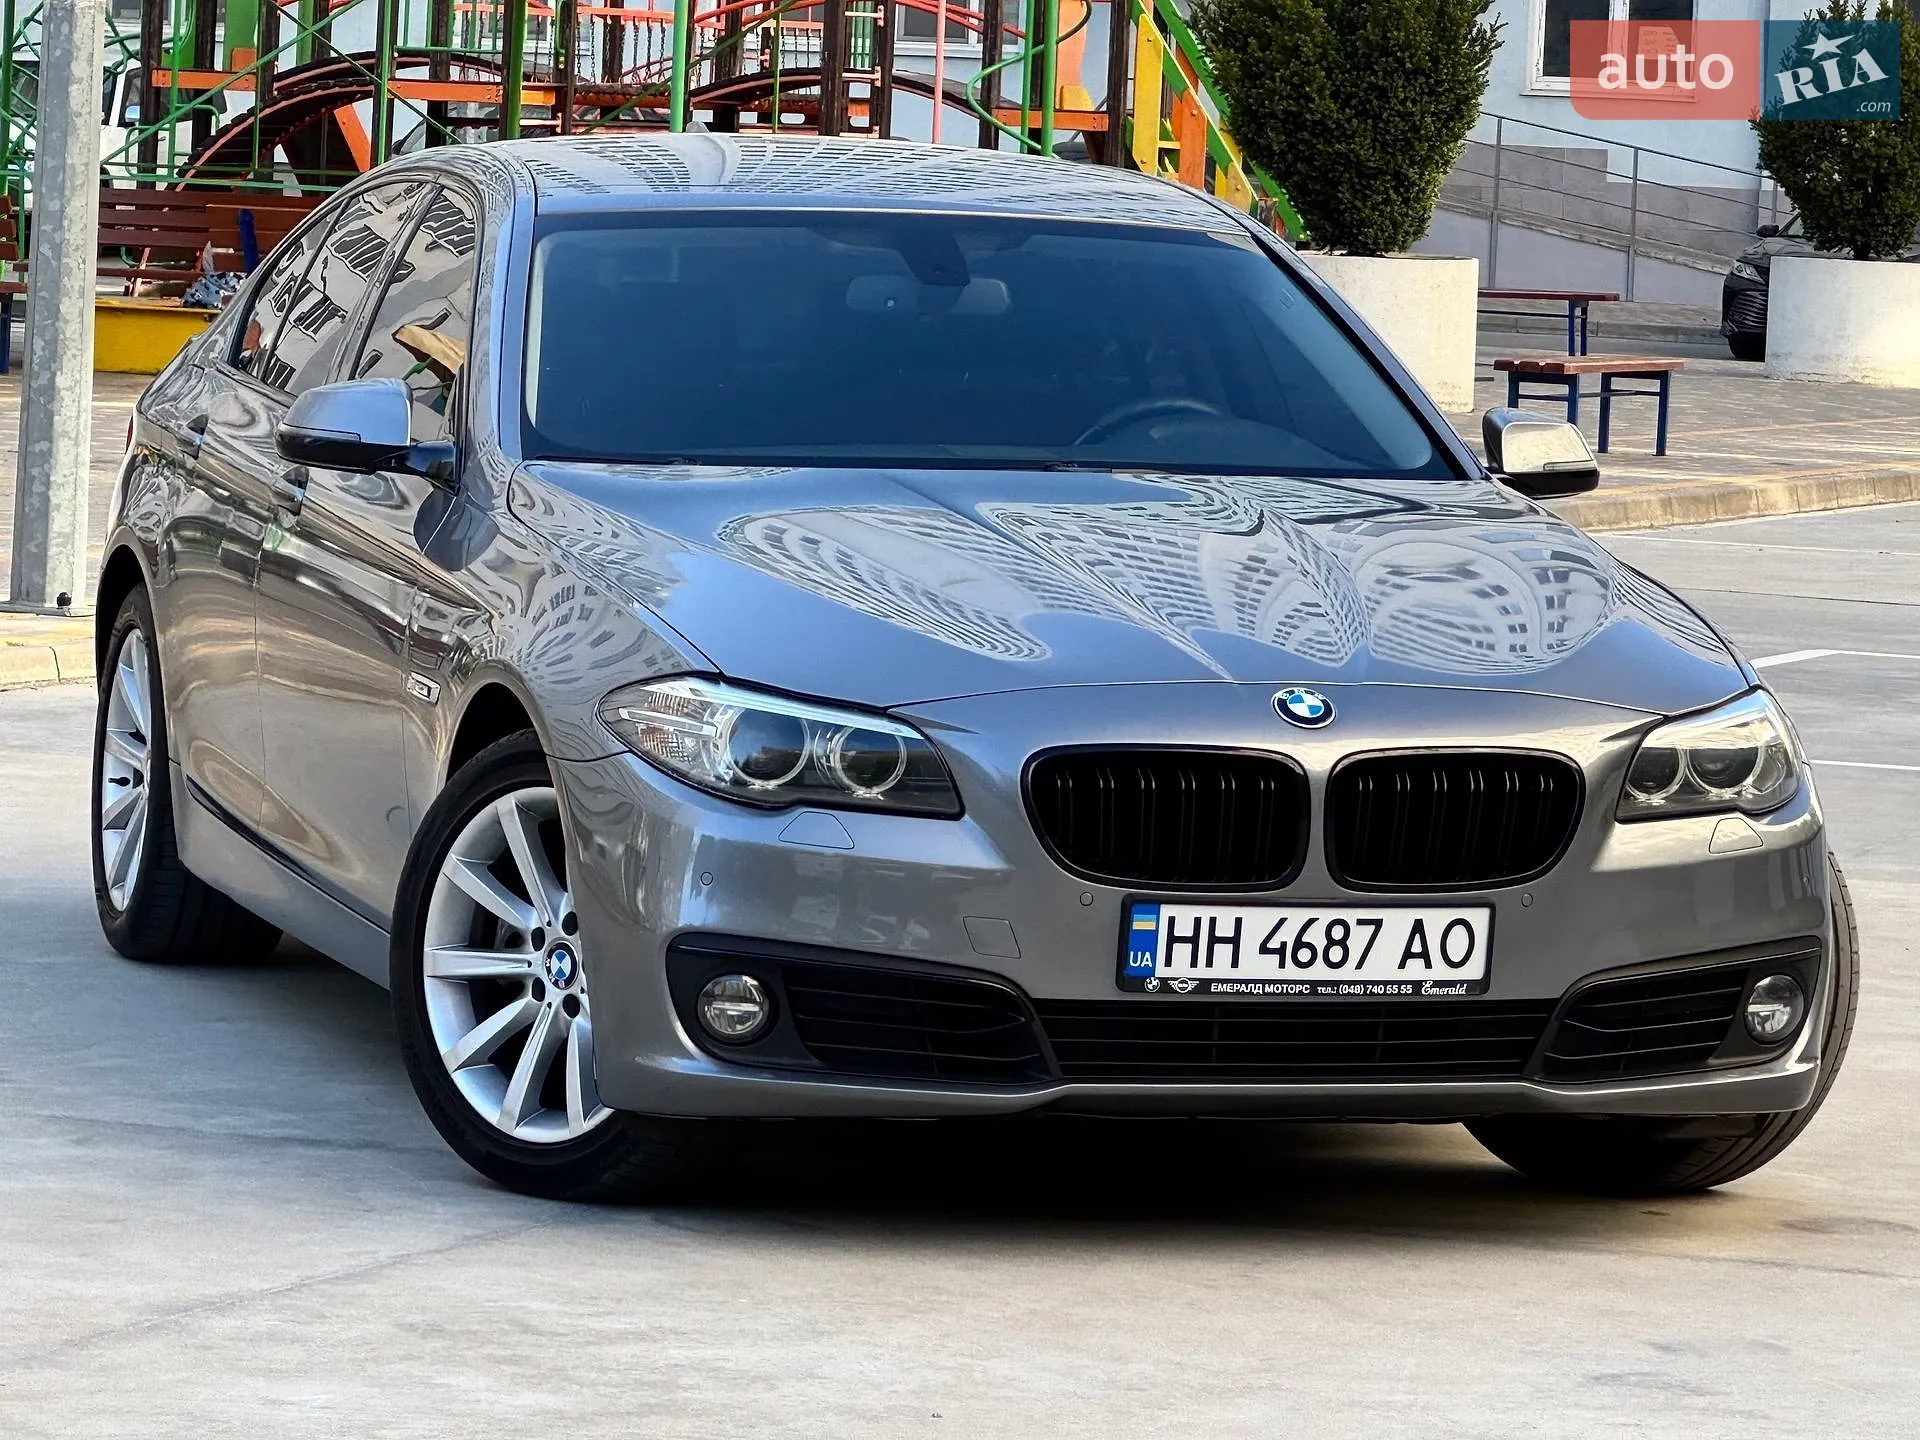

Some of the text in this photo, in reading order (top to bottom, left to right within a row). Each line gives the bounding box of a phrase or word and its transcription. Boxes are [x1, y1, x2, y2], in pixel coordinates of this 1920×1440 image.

[1163, 915, 1476, 970] HH 4687 AO
[1129, 951, 1153, 968] UA
[1210, 983, 1263, 994] ЕМЕРАЛД
[1264, 983, 1311, 994] МОТОРС
[1338, 984, 1365, 995] (048)
[1366, 984, 1385, 994] 740
[1400, 985, 1413, 994] 55
[1421, 981, 1468, 995] Emerald
